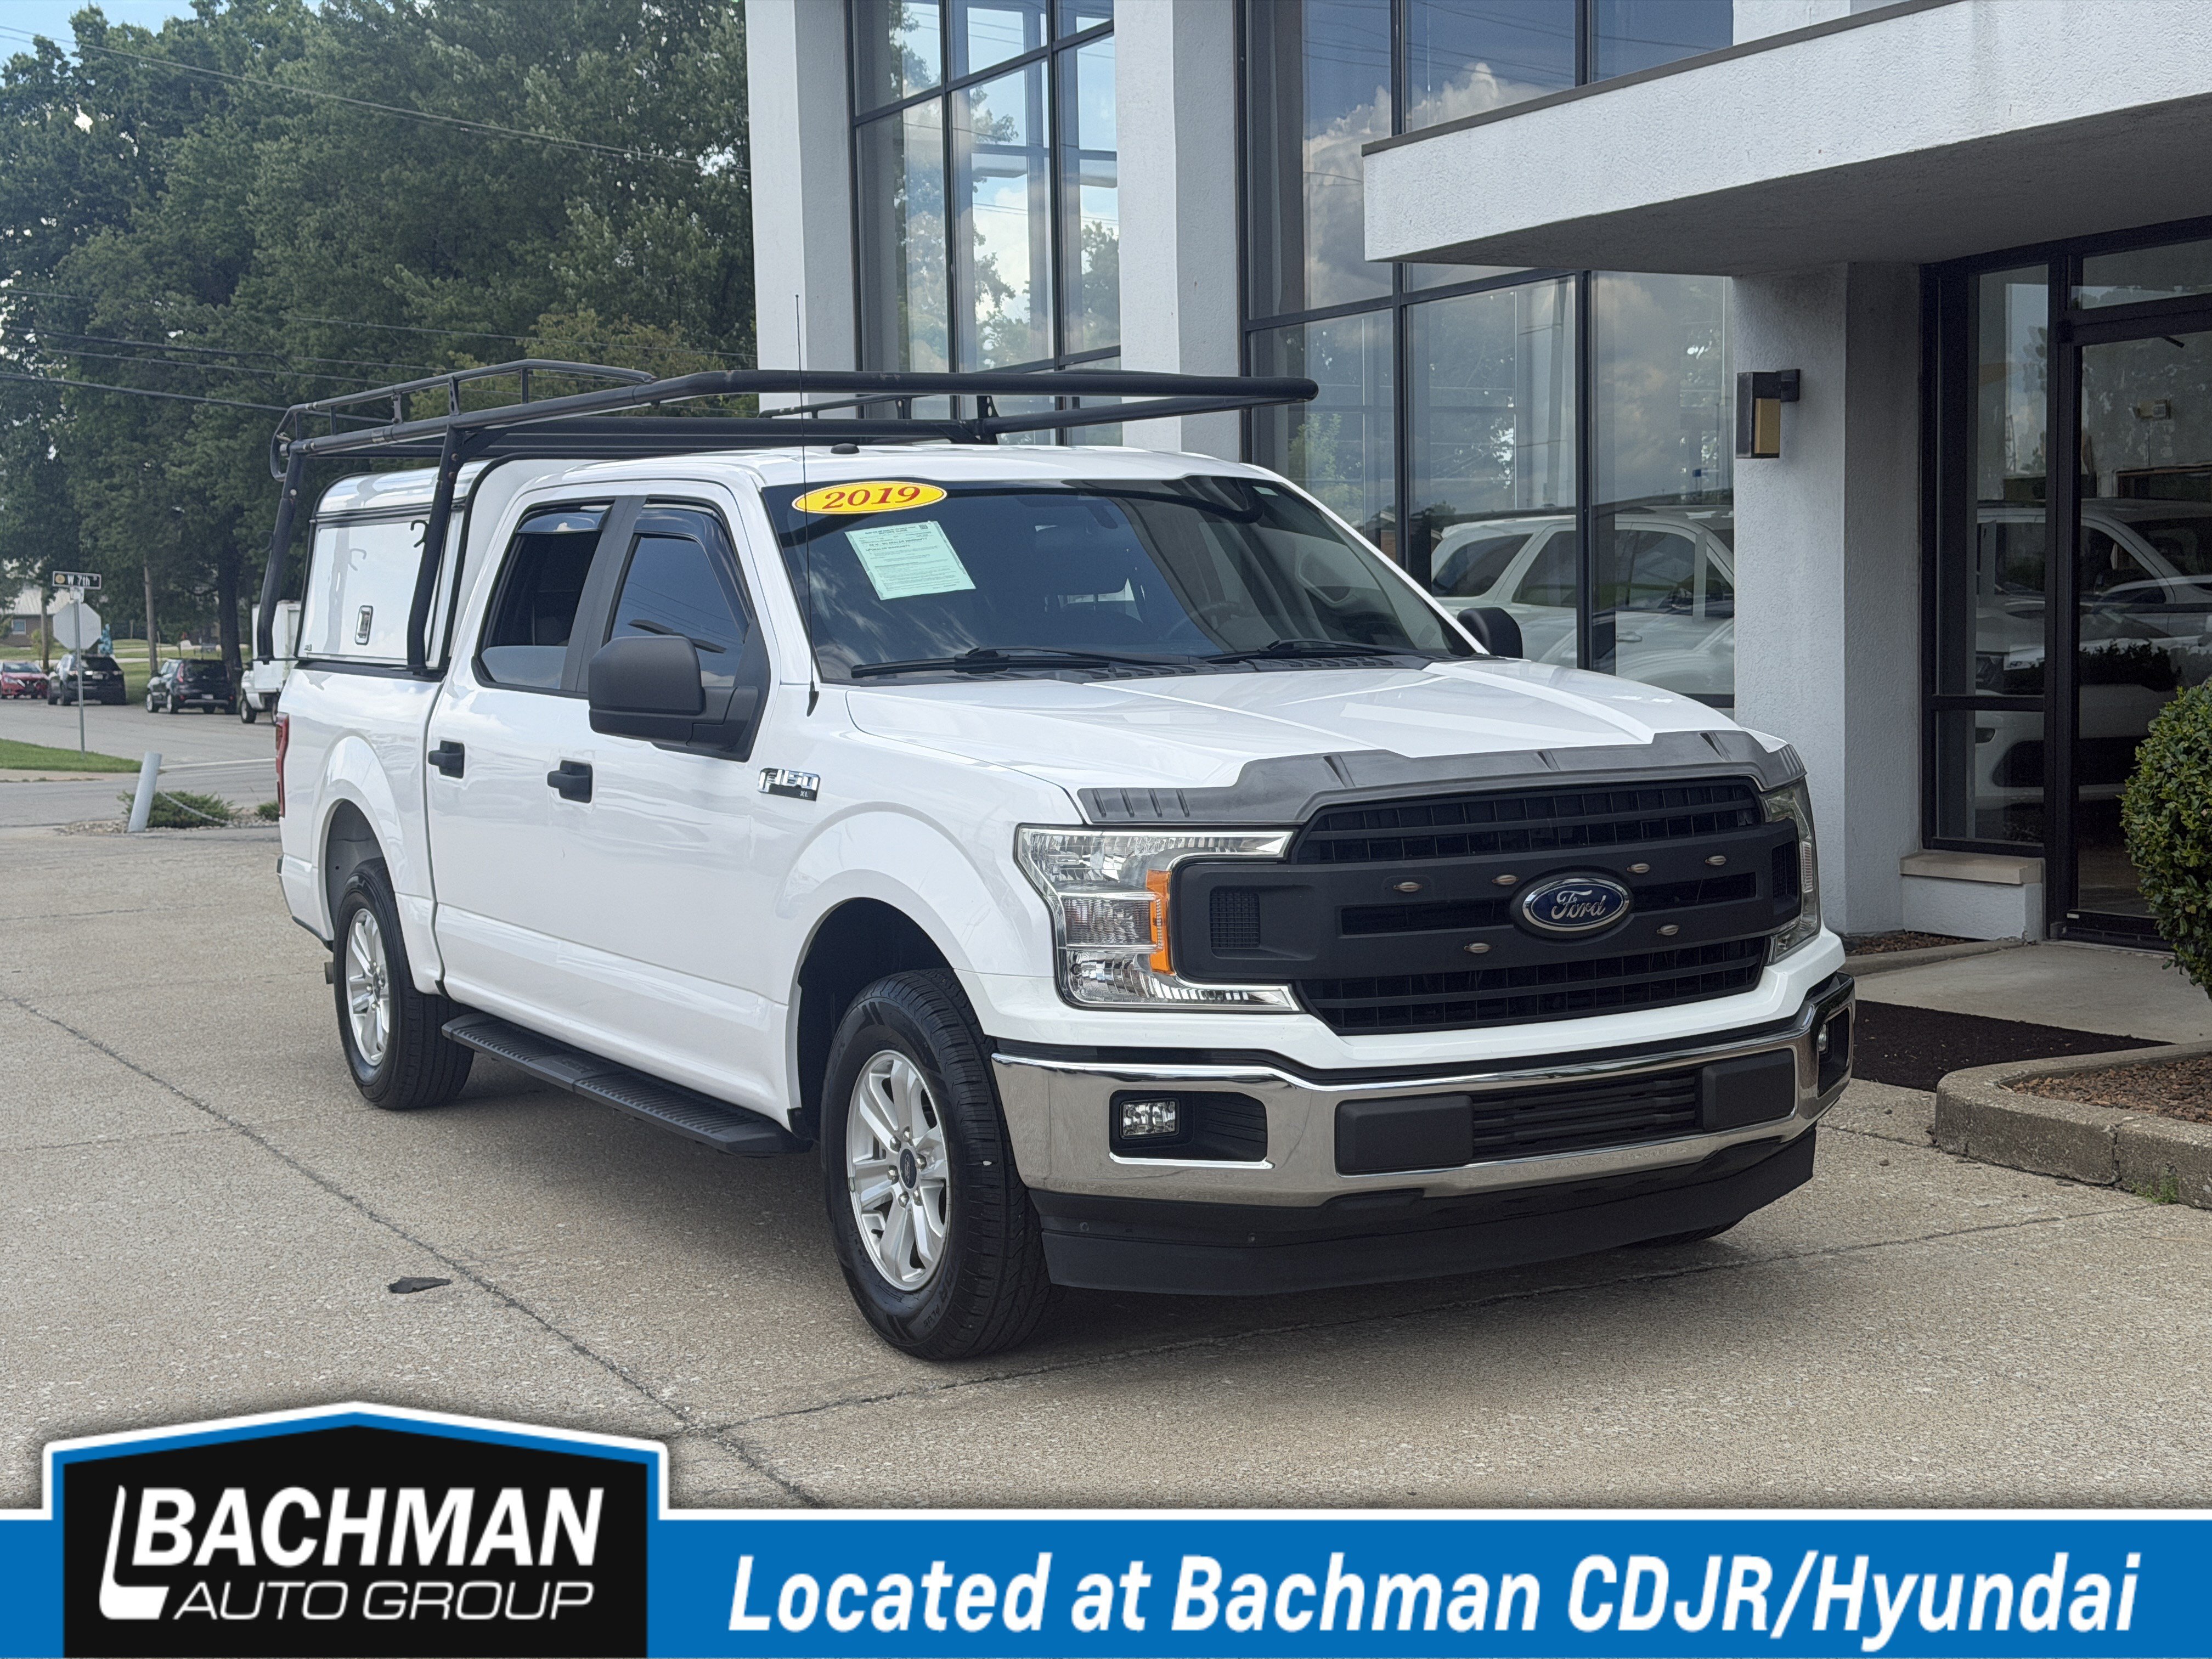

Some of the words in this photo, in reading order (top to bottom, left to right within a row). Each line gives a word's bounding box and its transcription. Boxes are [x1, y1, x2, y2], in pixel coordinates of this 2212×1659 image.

[822, 486, 921, 509] 2019
[67, 574, 74, 585] W
[1551, 890, 1607, 919] Ford
